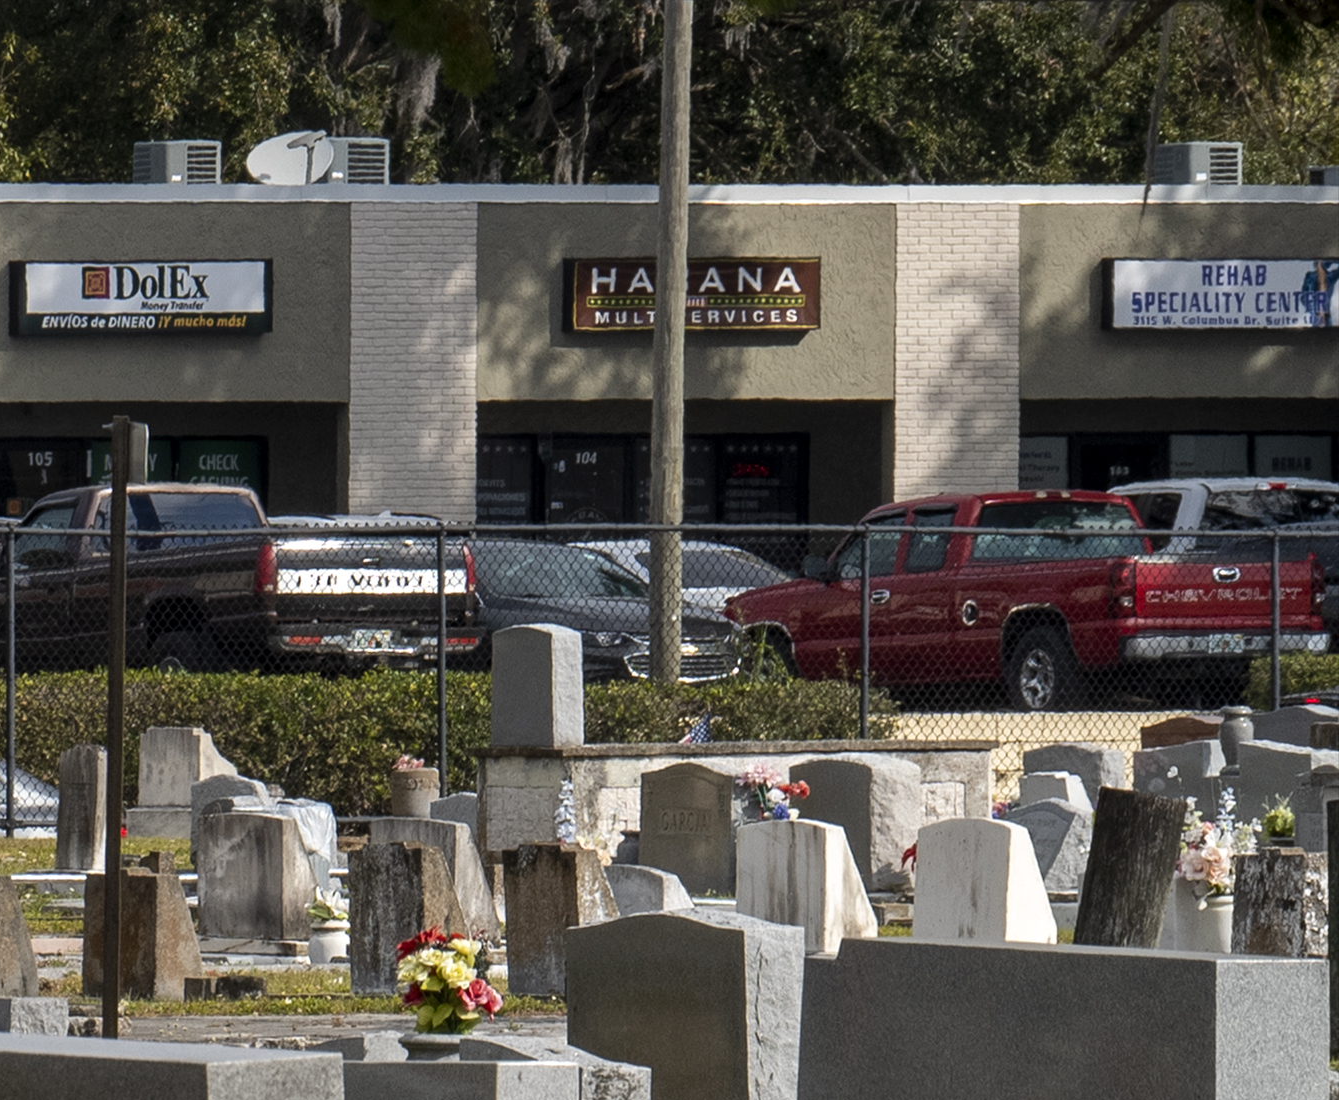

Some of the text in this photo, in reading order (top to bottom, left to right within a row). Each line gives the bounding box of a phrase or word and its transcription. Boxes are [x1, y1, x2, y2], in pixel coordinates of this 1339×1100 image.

[113, 265, 210, 300] DolEx
[591, 267, 801, 293] HAANA
[1202, 265, 1267, 286] REHAB
[141, 301, 204, 312] Money Transfer
[1131, 292, 1328, 313] SPECIALITY CENTER
[42, 314, 88, 329] ENVÍOS
[91, 316, 106, 329] de
[108, 316, 155, 329] DINERO
[174, 316, 214, 328] mucho
[217, 315, 246, 328] más!
[595, 309, 798, 325] MULT ERVICES
[1163, 316, 1176, 325] W.
[1182, 315, 1240, 325] Columbus
[1244, 316, 1261, 325] Dr.
[1266, 315, 1299, 326] Suite
[27, 451, 53, 467] 105
[198, 453, 240, 472] CHECK
[575, 452, 597, 464] 104
[661, 811, 712, 833] GARCIA
